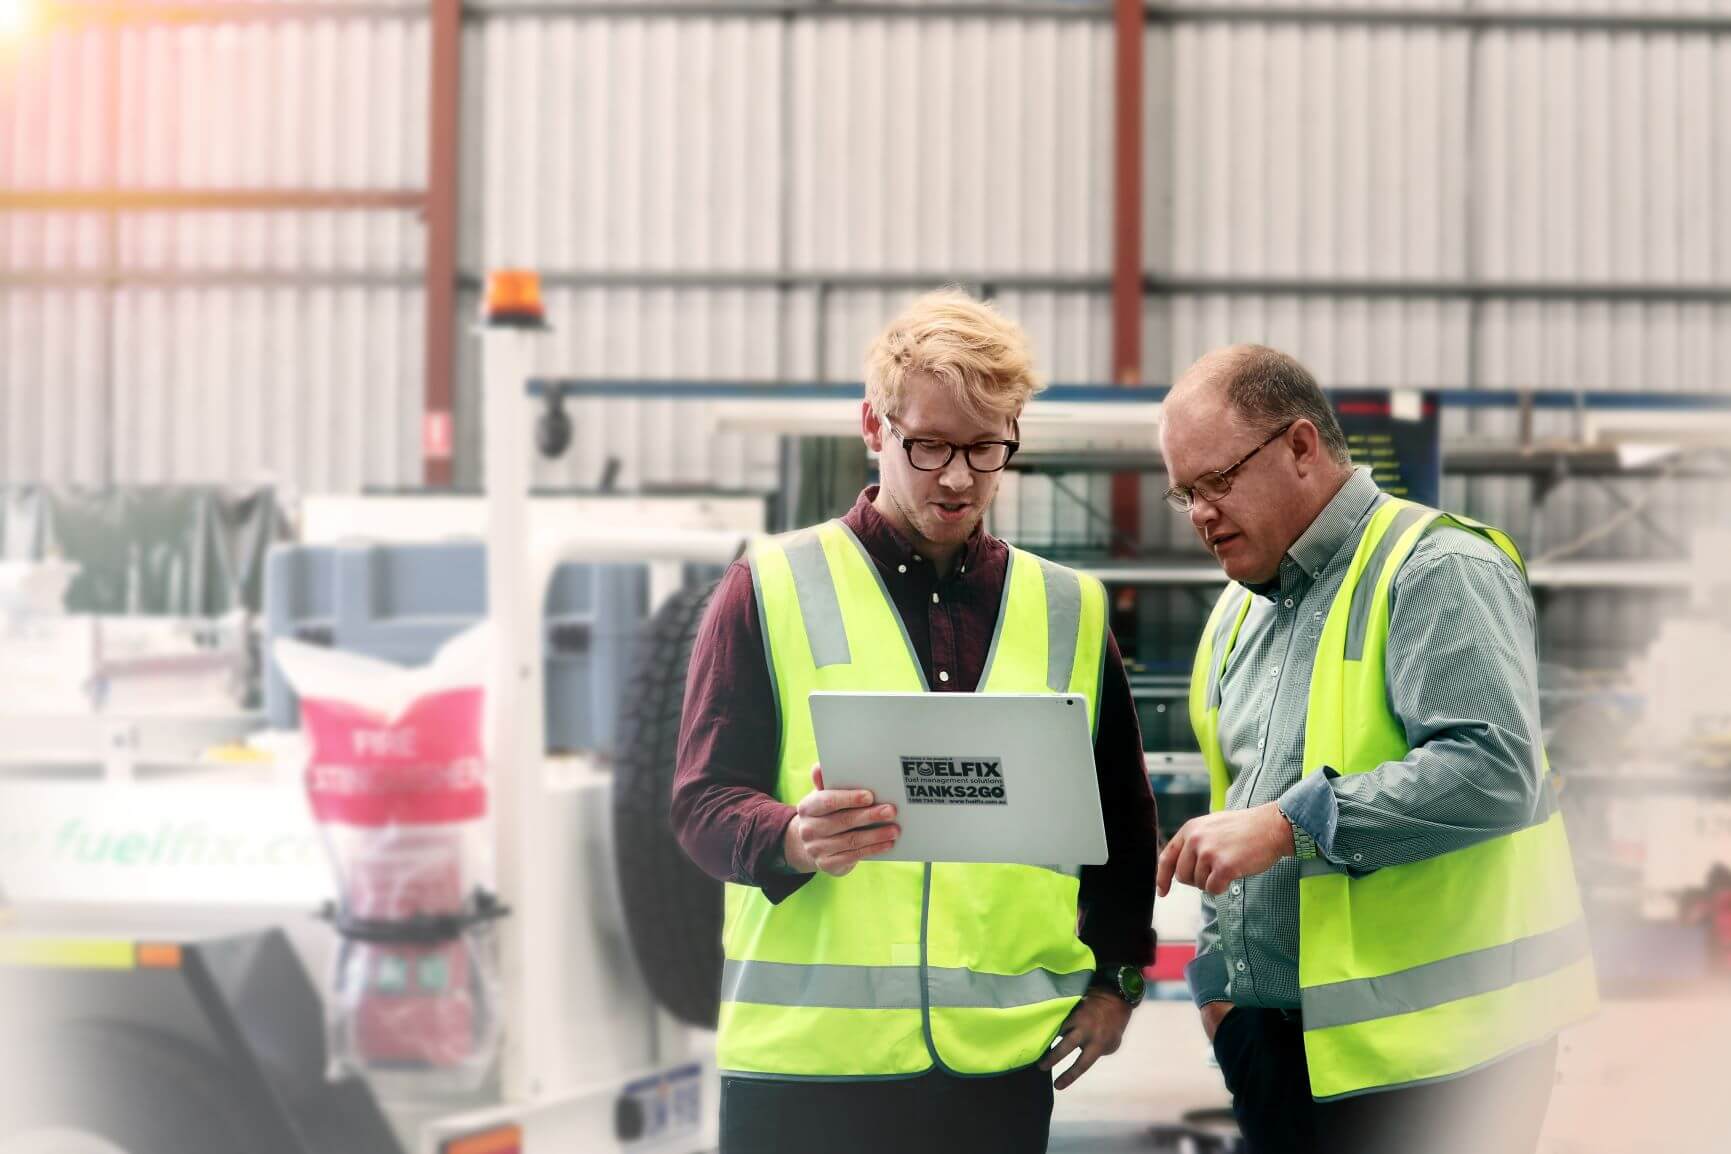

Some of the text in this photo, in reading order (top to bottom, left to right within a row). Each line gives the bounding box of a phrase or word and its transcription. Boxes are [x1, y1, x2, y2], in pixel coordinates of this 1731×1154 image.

[901, 761, 1001, 777] FUELFIX
[920, 777, 969, 785] management
[906, 785, 1005, 798] TANKS2GO
